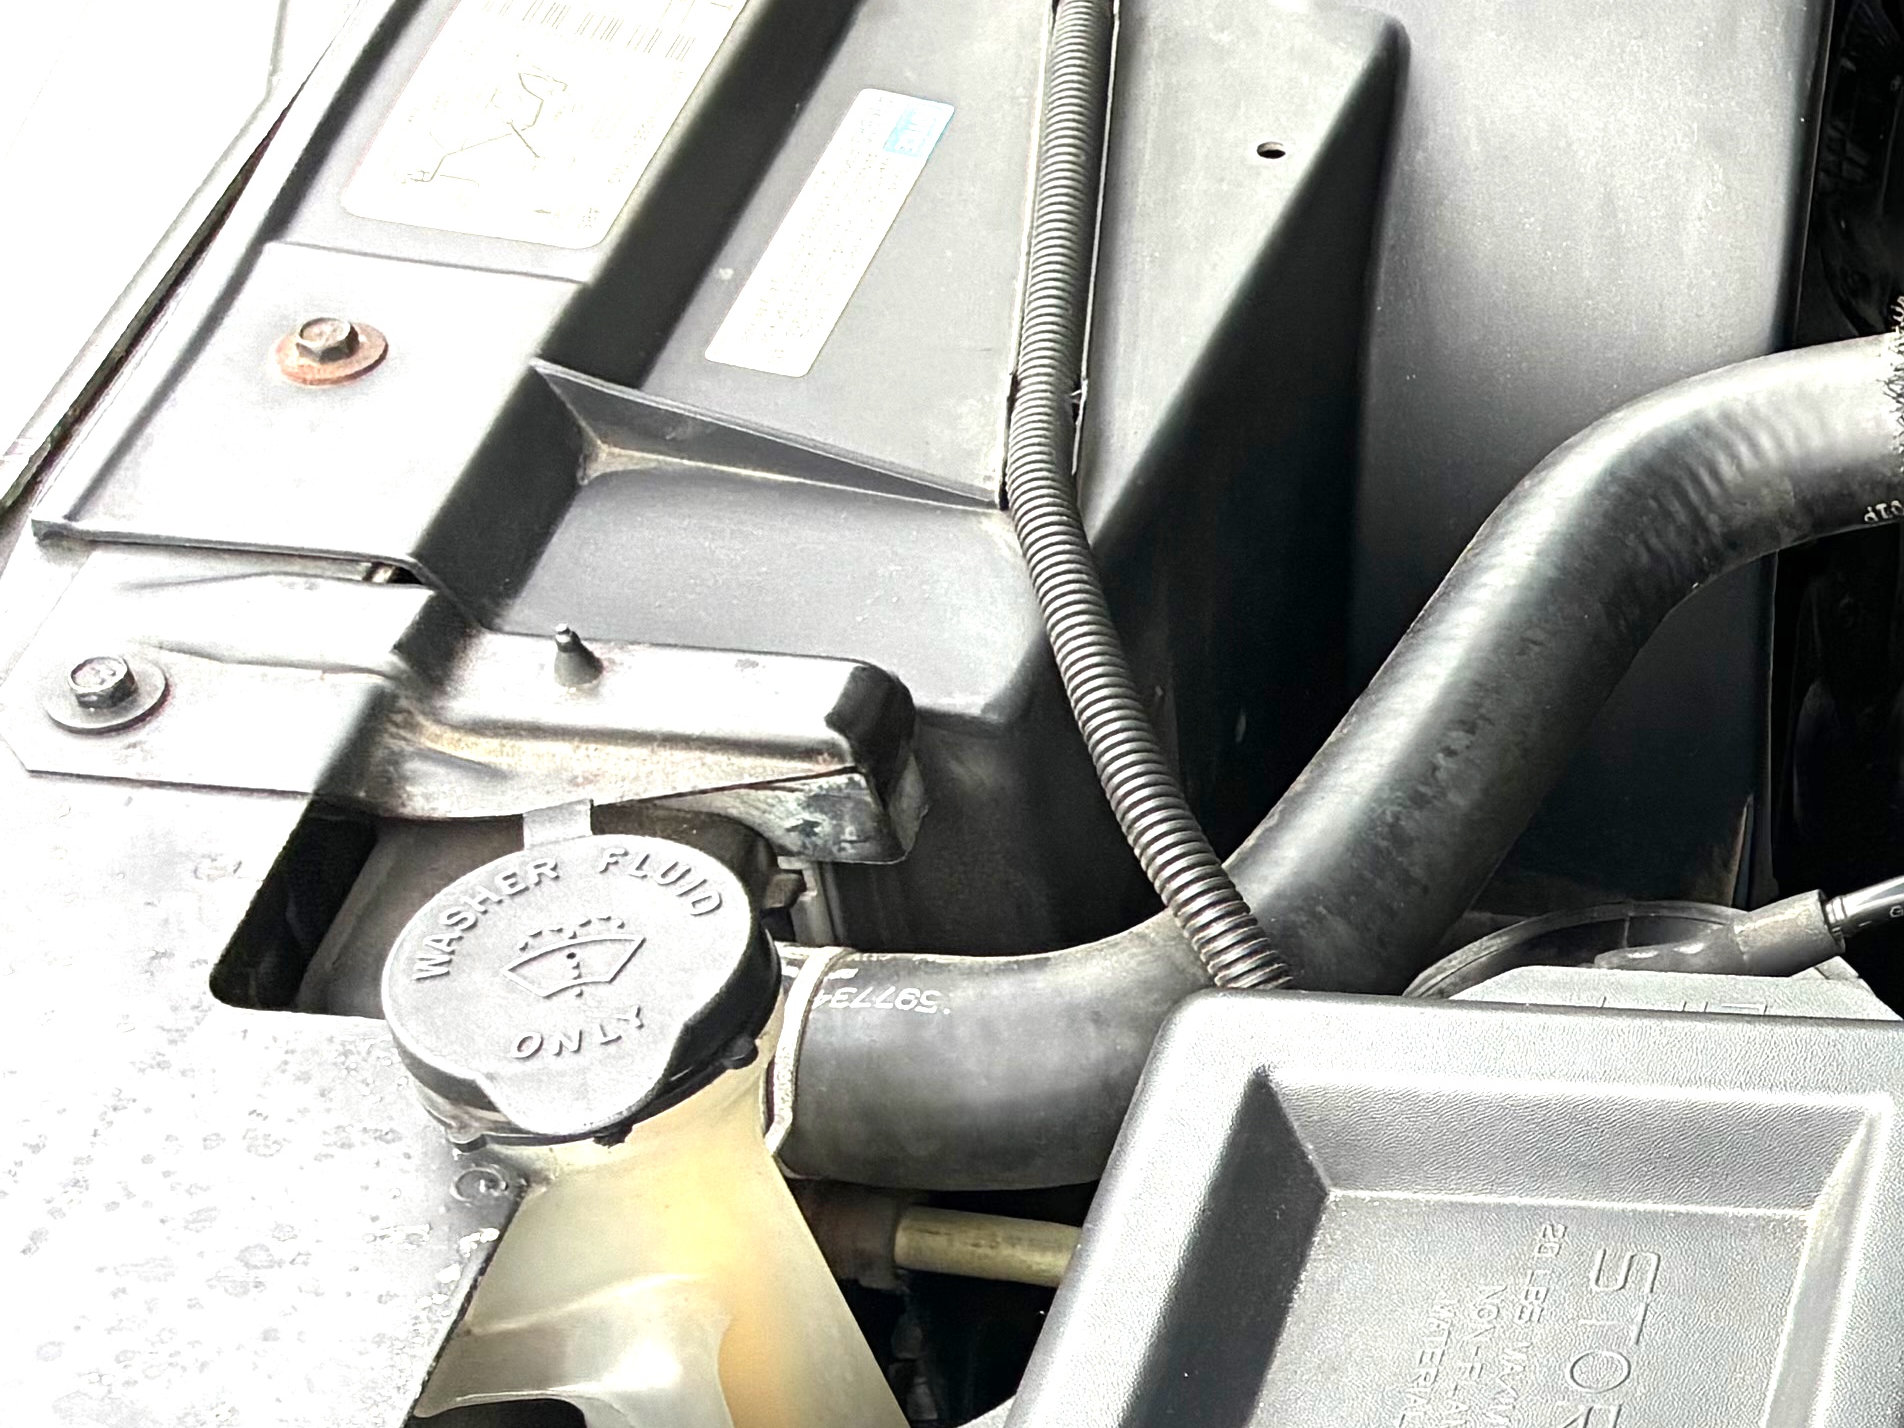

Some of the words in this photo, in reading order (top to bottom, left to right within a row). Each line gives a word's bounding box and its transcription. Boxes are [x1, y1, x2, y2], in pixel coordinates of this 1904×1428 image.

[411, 854, 560, 982] WASHER
[596, 846, 724, 919] FLUID
[510, 1004, 644, 1060] ONLY
